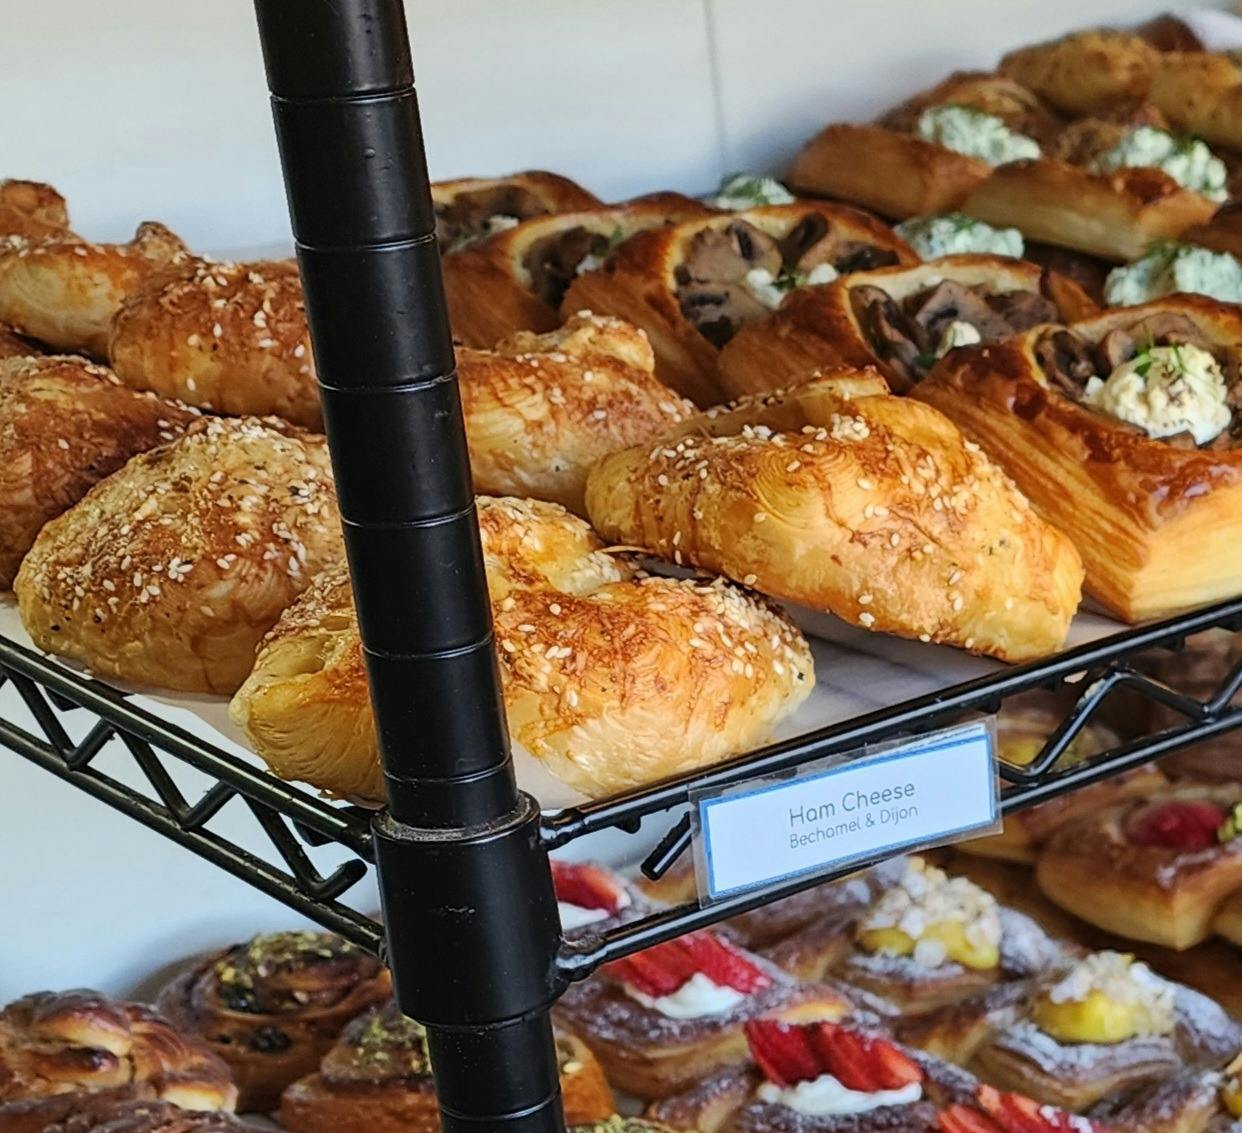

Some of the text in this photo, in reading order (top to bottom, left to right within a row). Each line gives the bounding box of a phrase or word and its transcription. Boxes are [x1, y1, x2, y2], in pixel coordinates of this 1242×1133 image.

[789, 782, 915, 827] Ham Cheese
[790, 804, 918, 849] Bechamel & Dijon
